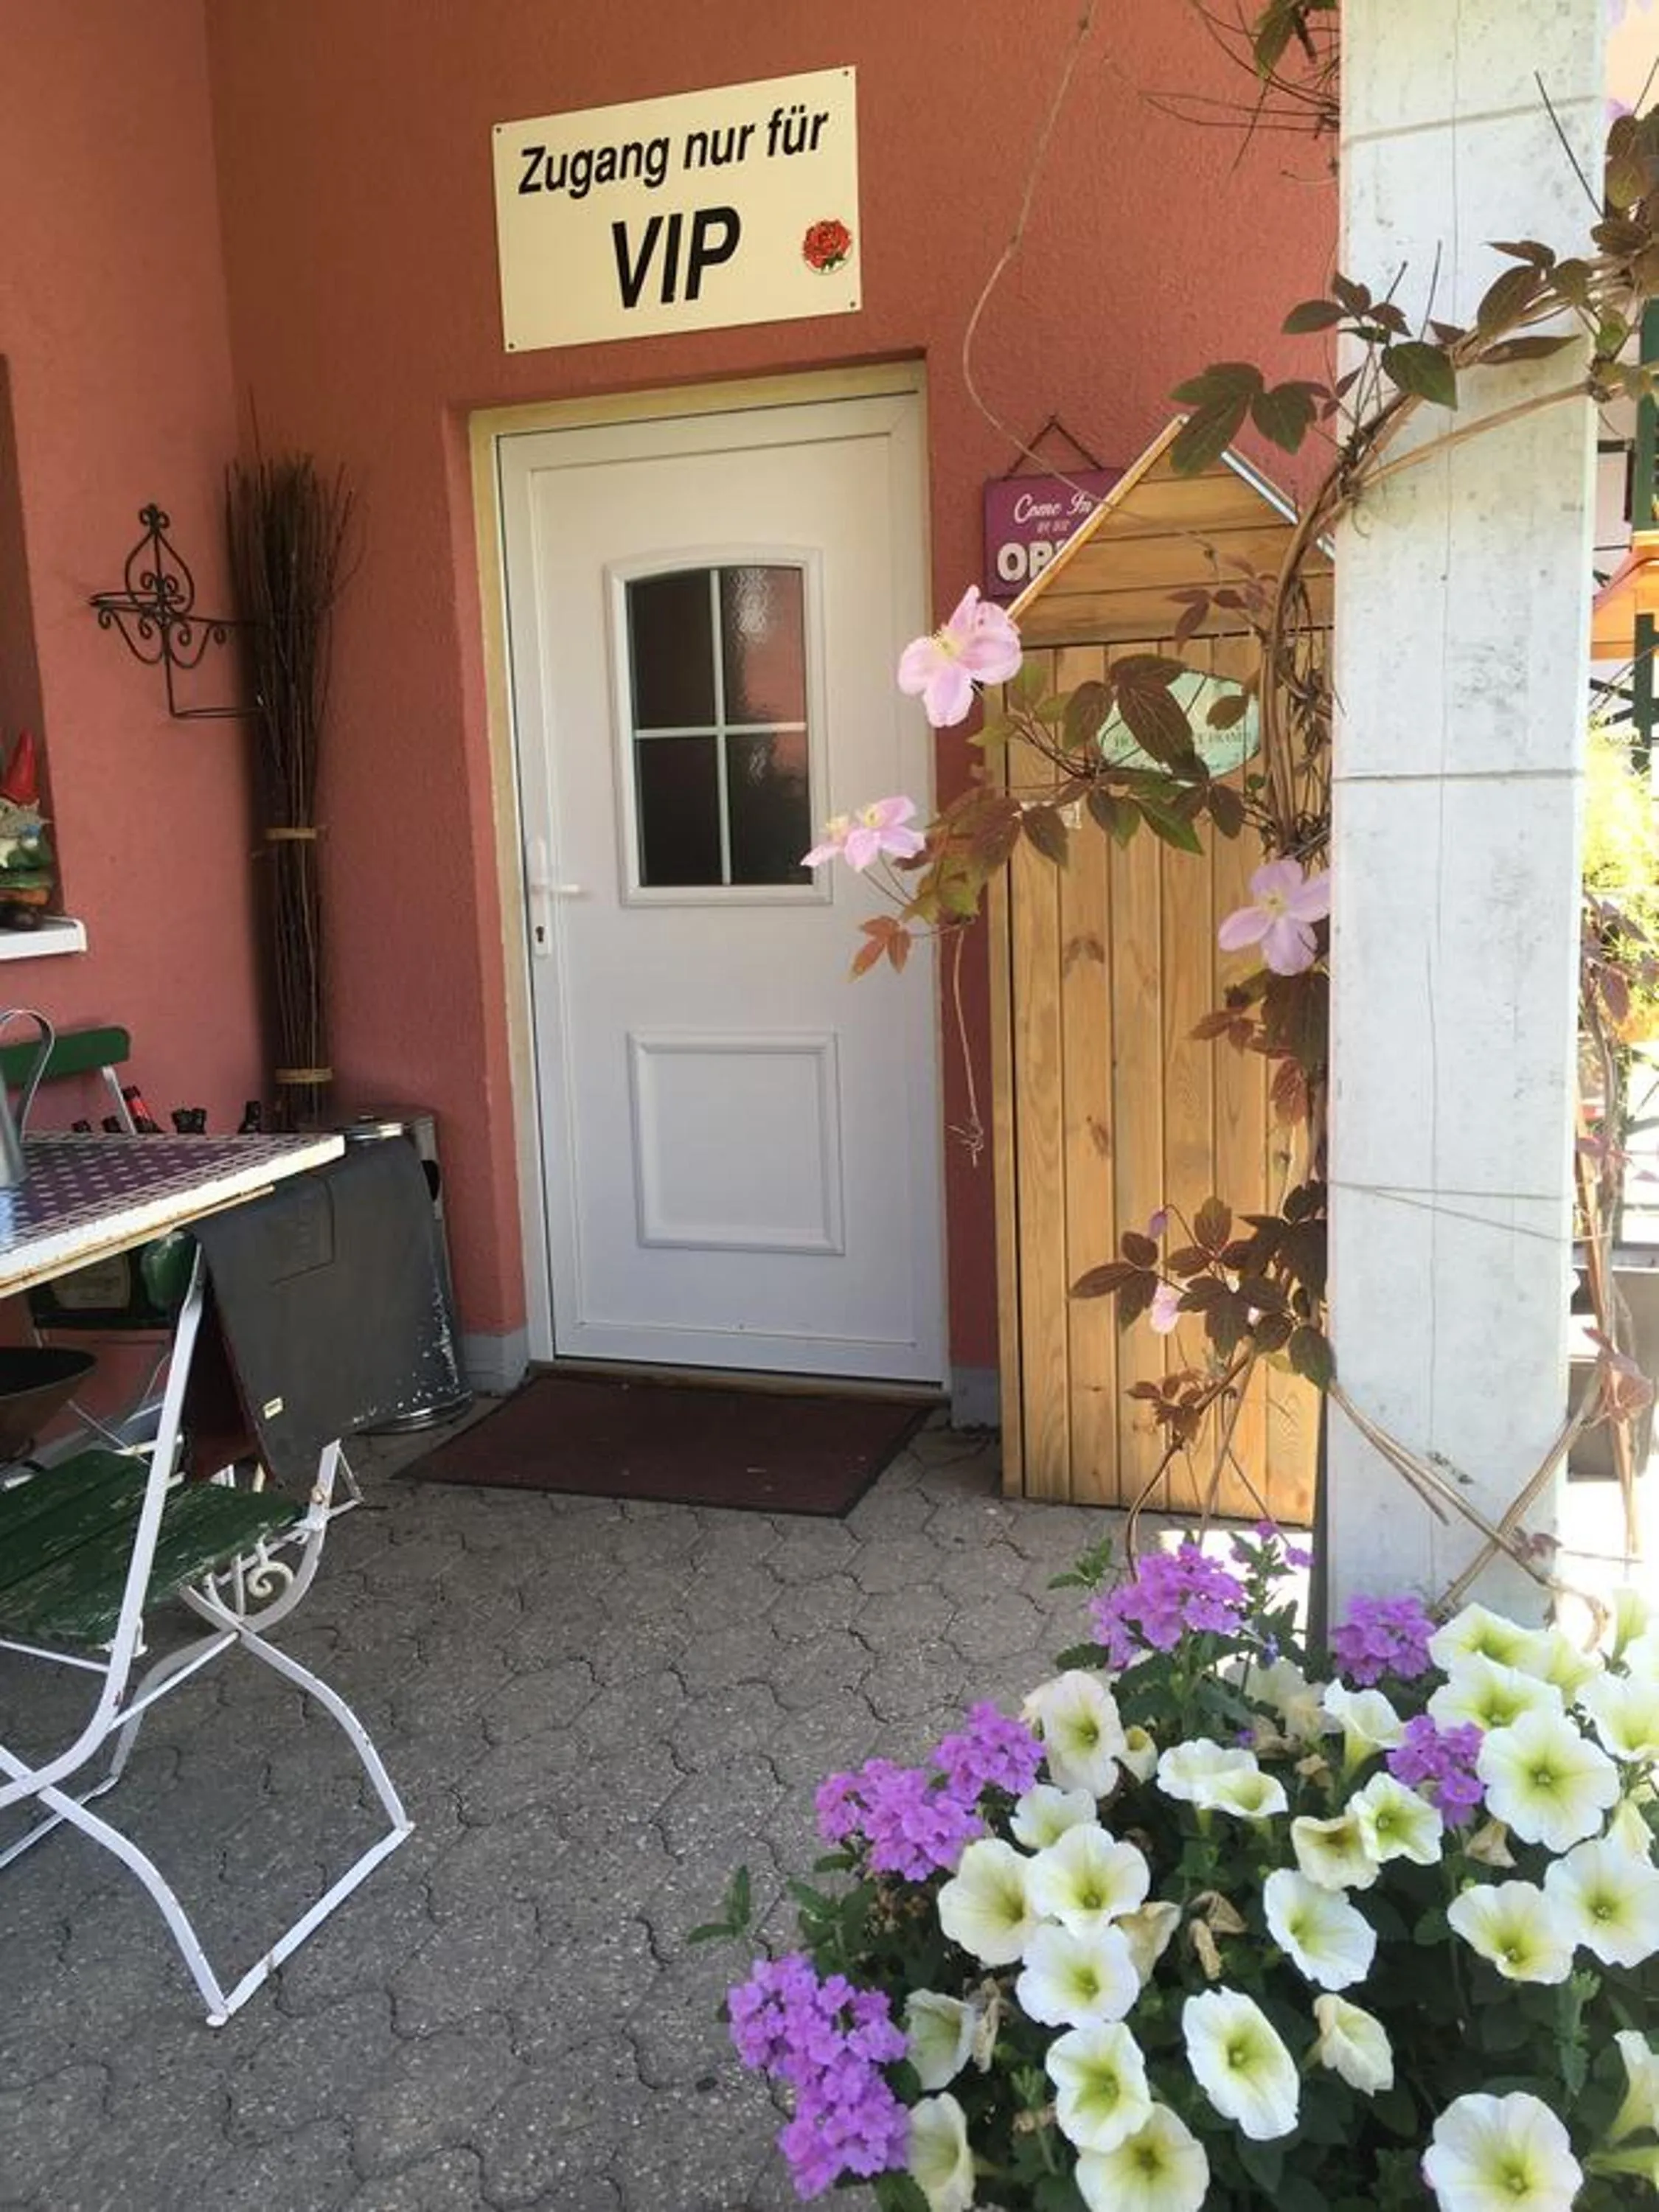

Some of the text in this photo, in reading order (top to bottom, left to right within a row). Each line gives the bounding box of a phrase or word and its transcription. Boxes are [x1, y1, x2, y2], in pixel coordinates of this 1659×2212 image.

[518, 105, 828, 199] Zugang nur für
[611, 206, 741, 309] VIP
[1015, 494, 1061, 523] Come
[998, 540, 1067, 581] OP
